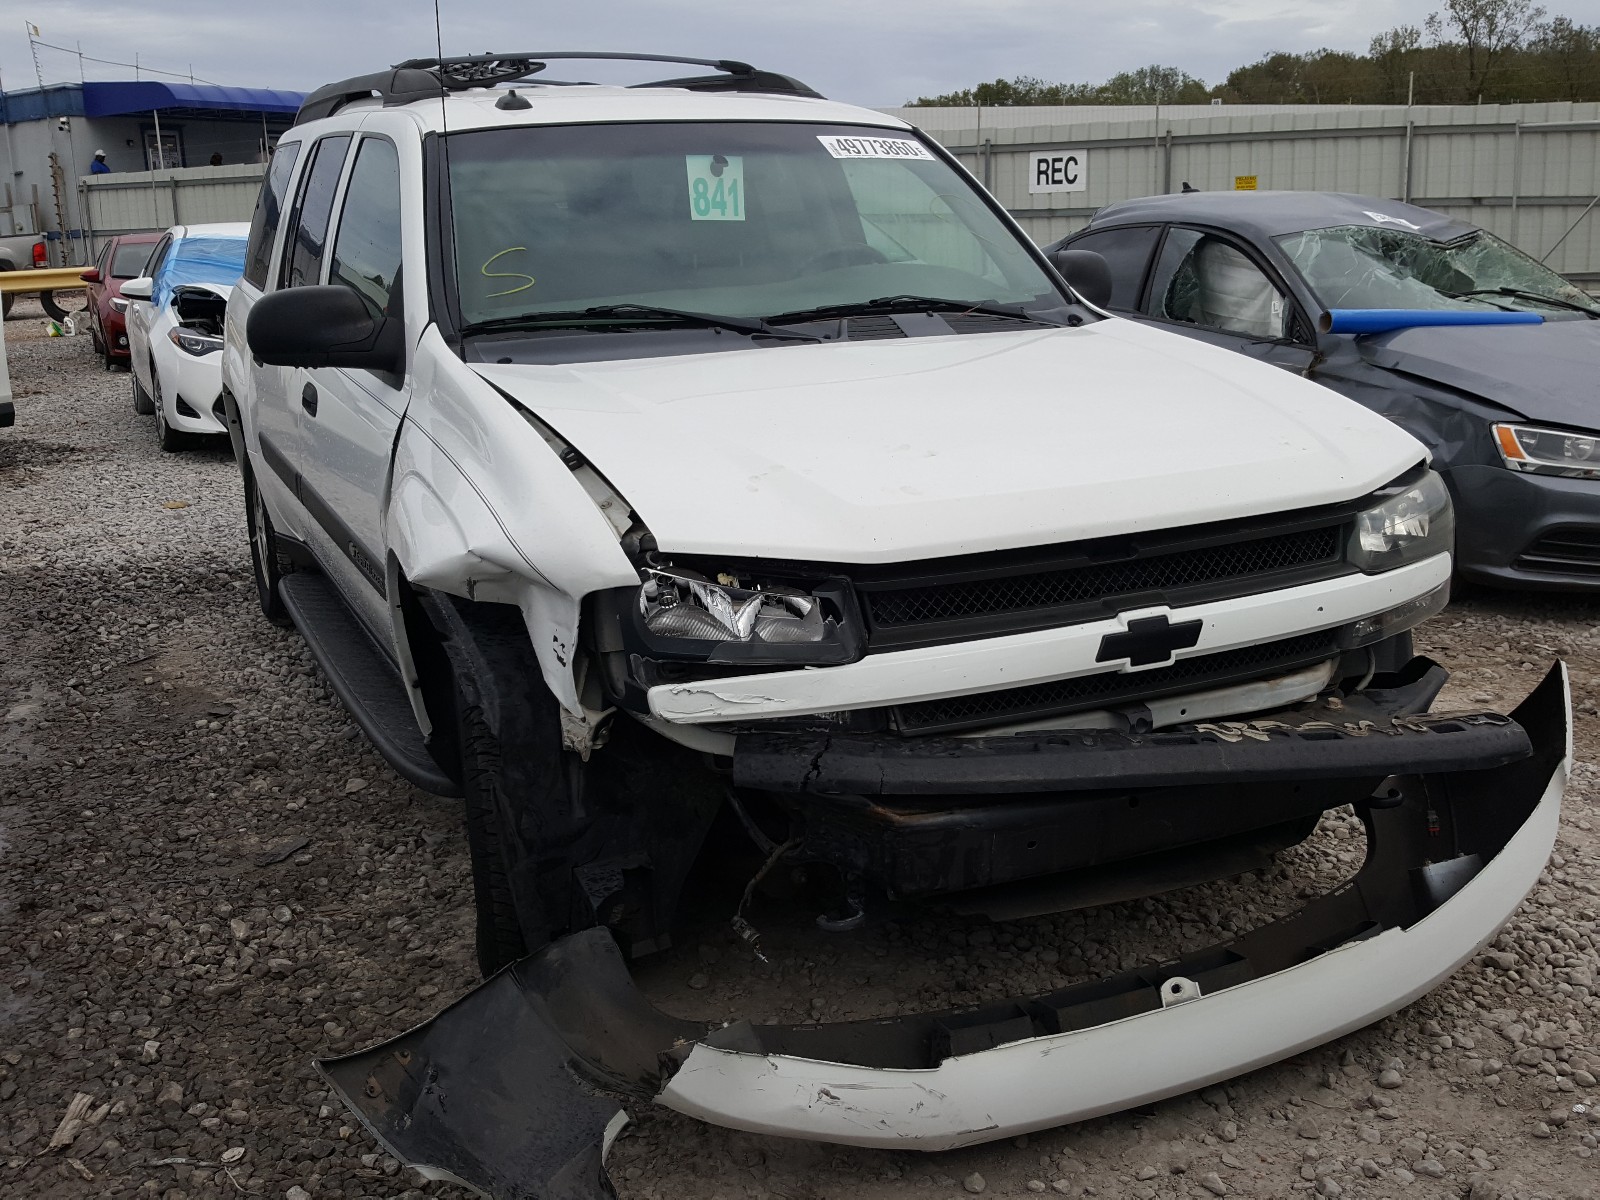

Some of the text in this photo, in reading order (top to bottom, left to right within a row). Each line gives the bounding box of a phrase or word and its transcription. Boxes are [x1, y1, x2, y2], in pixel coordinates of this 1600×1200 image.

[836, 138, 918, 156] 49773860
[1036, 156, 1079, 186] REC
[692, 177, 739, 217] 841
